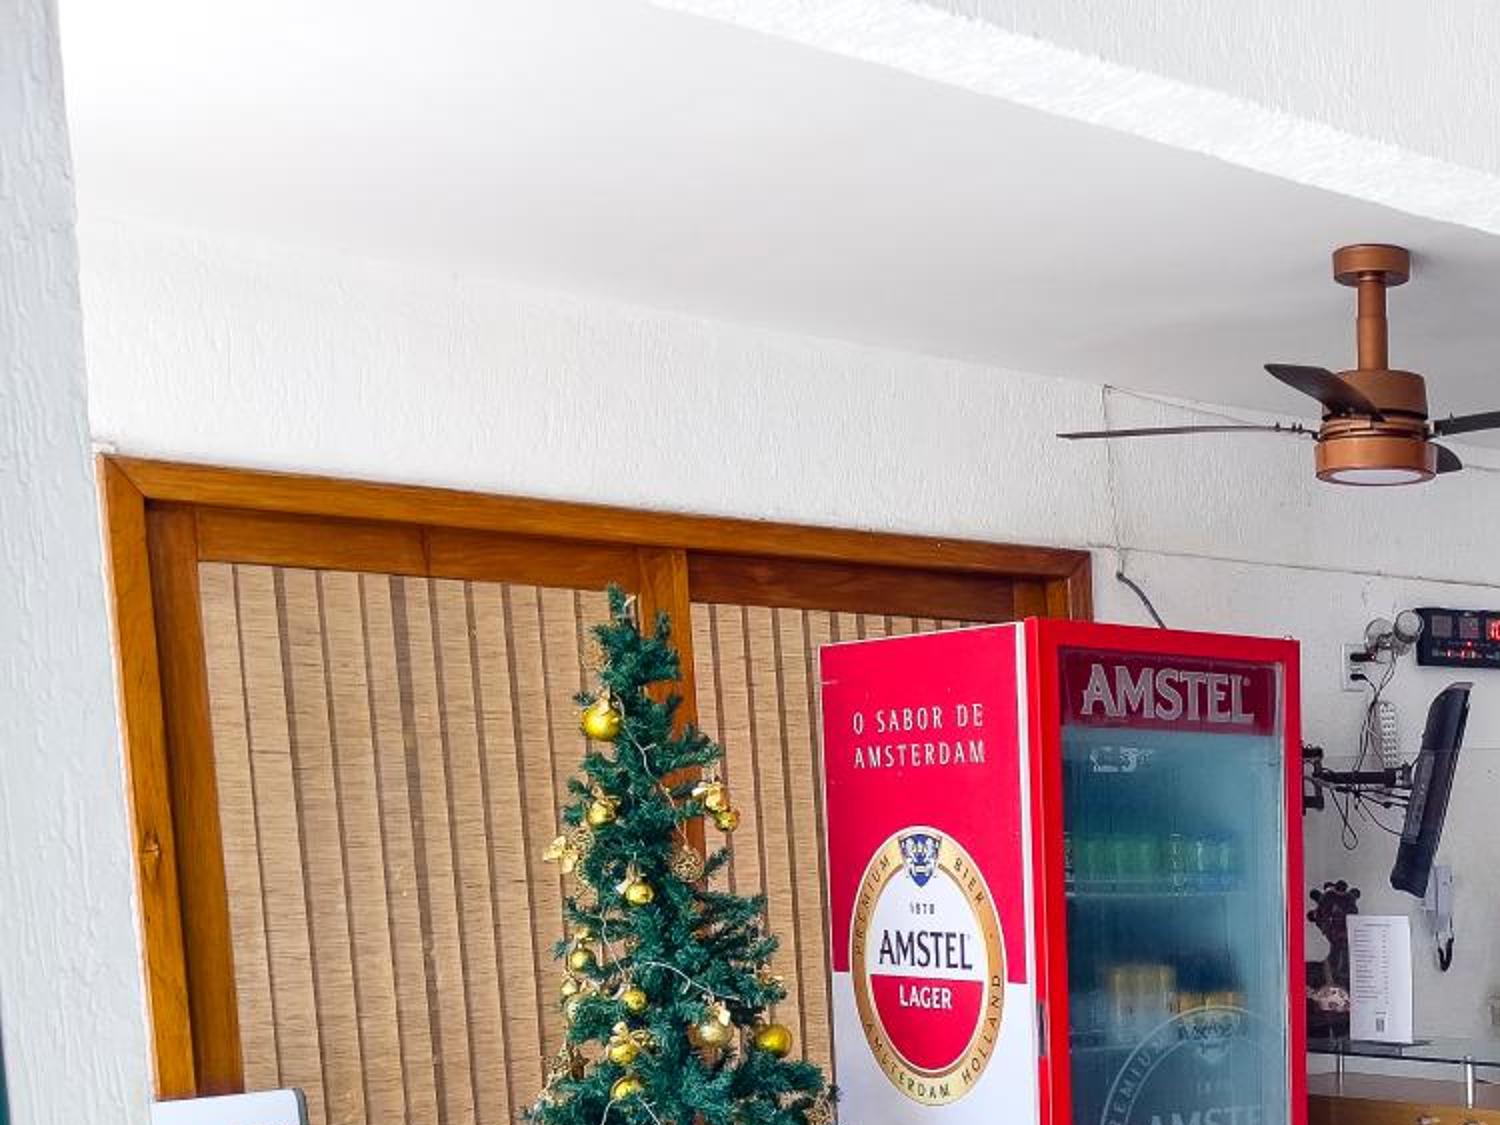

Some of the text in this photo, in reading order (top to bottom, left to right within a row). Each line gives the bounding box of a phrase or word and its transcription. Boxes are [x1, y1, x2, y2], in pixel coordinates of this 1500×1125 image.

[853, 703, 983, 735] O SABOR DE
[1080, 663, 1255, 724] AMSTEL
[853, 740, 985, 769] AMSTERDAM
[857, 854, 985, 955] PREMIUM BIER
[879, 929, 973, 970] AMSTEL
[899, 984, 953, 1009] LAGER
[961, 974, 1002, 1083] HOLLAND
[865, 1022, 952, 1097] AMSTERDAM
